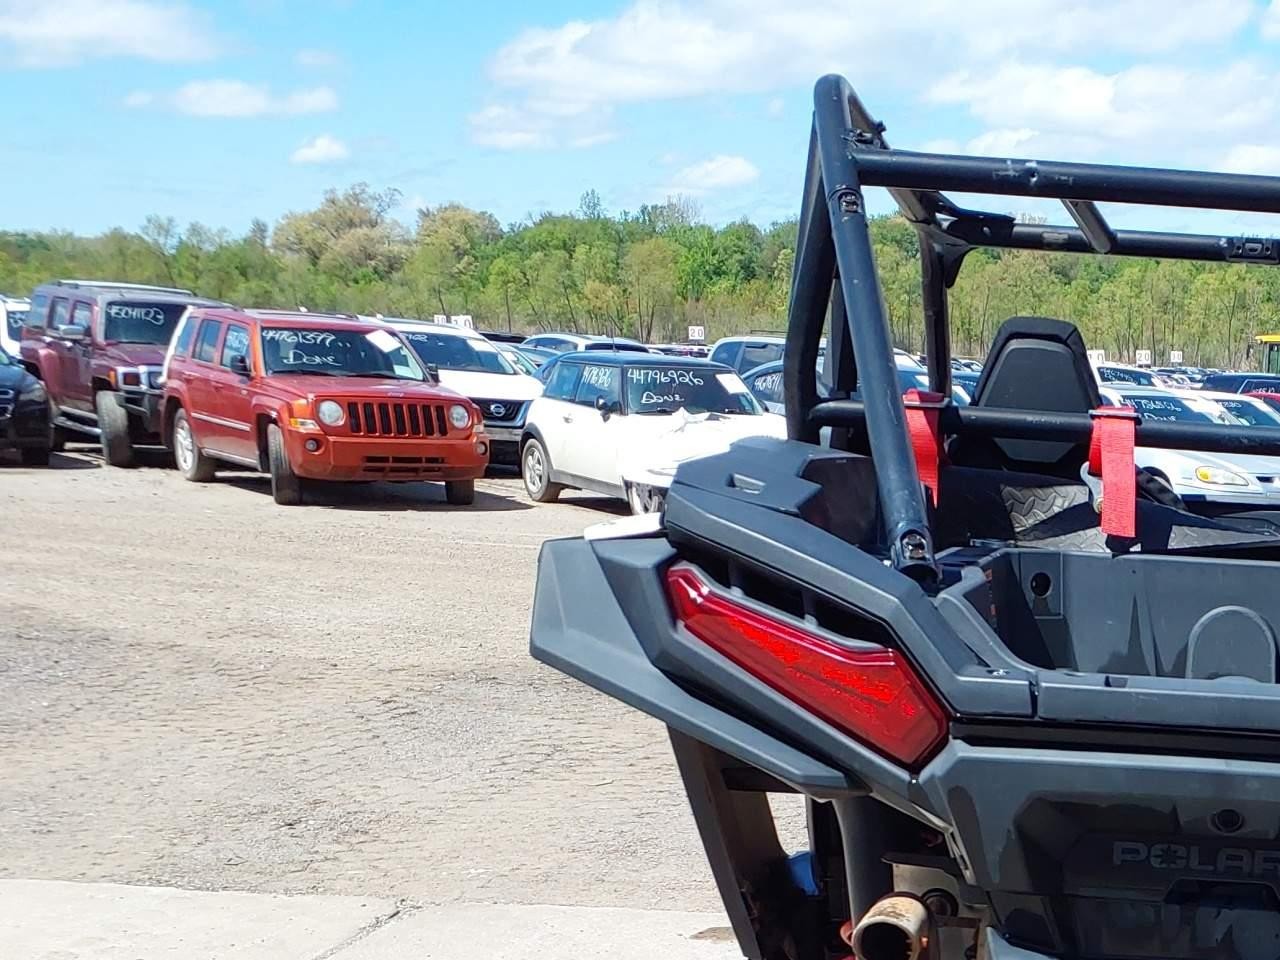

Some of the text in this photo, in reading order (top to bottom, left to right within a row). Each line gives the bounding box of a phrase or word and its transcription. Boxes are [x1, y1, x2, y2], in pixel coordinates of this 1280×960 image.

[690, 328, 704, 337] 20
[1137, 352, 1150, 361] 20
[627, 367, 704, 387] 44796926
